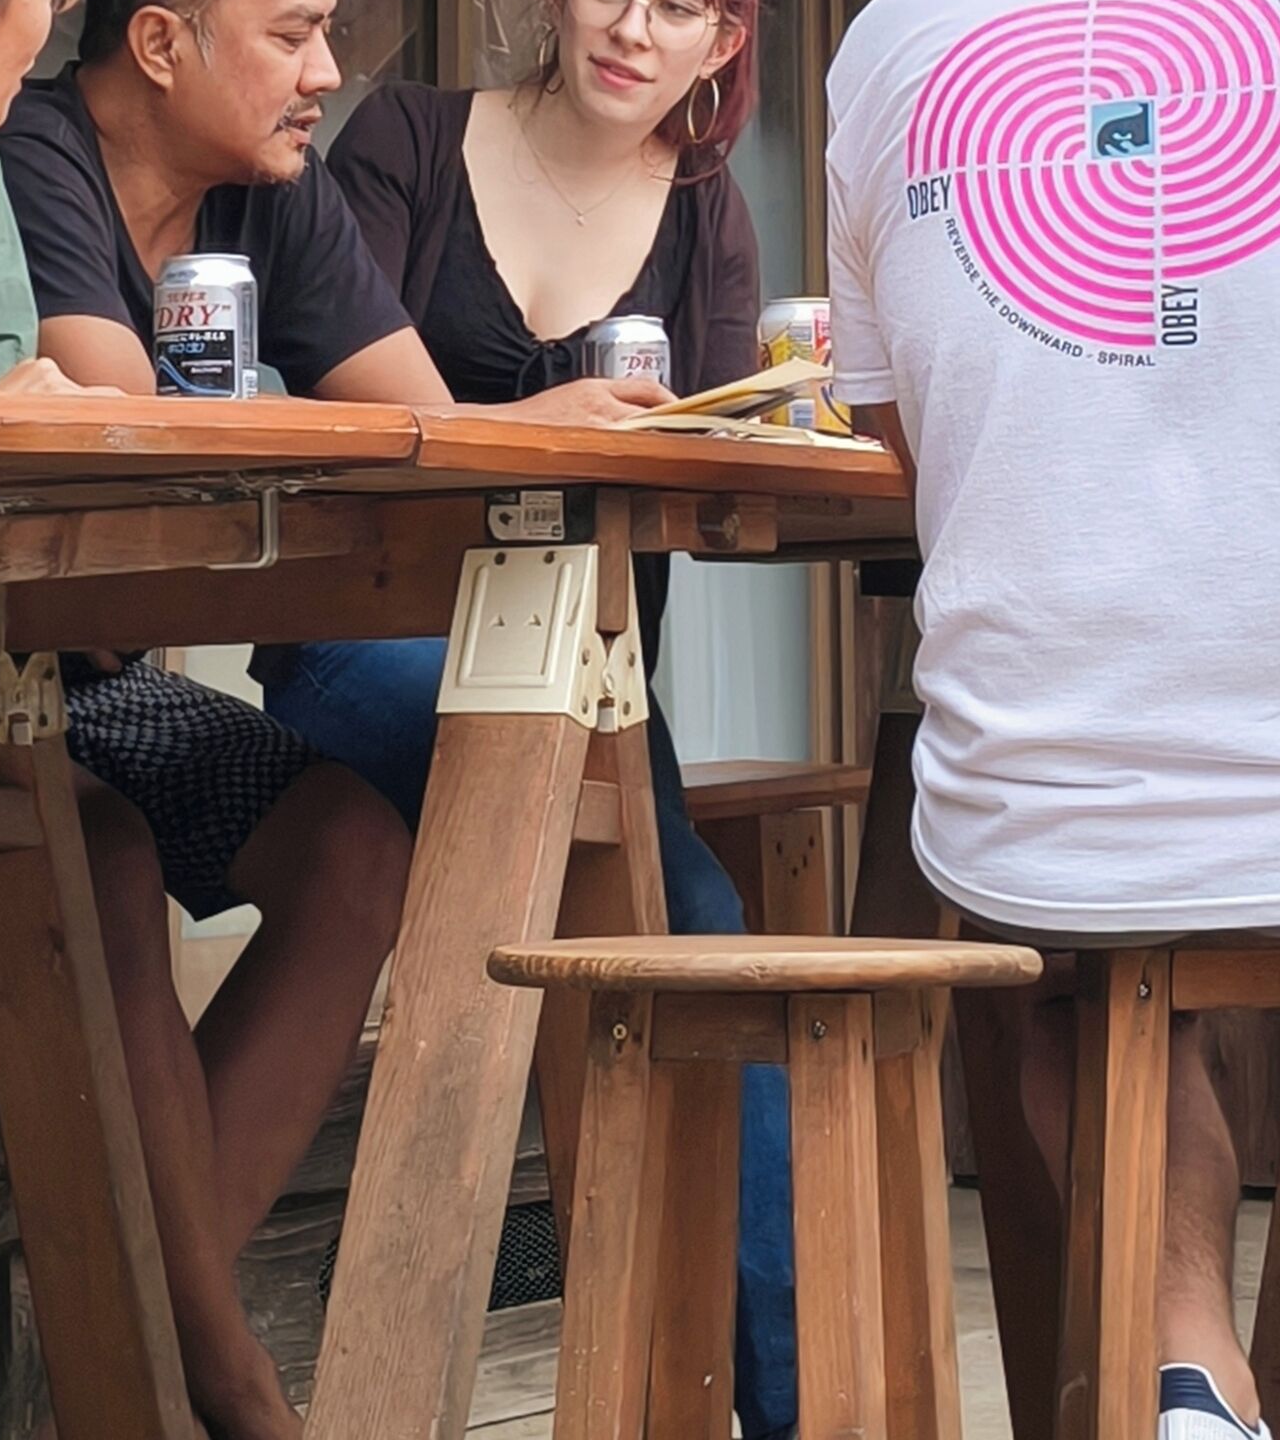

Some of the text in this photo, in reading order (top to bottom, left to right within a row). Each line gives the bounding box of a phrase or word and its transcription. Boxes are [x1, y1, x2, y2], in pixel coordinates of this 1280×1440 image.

[906, 174, 951, 220] OBEY
[945, 217, 980, 283] REVERSE
[977, 280, 1000, 309] THE
[998, 304, 1083, 358] DOWNWARD
[1097, 350, 1155, 367] SPIRAL
[1161, 283, 1198, 346] OBEY
